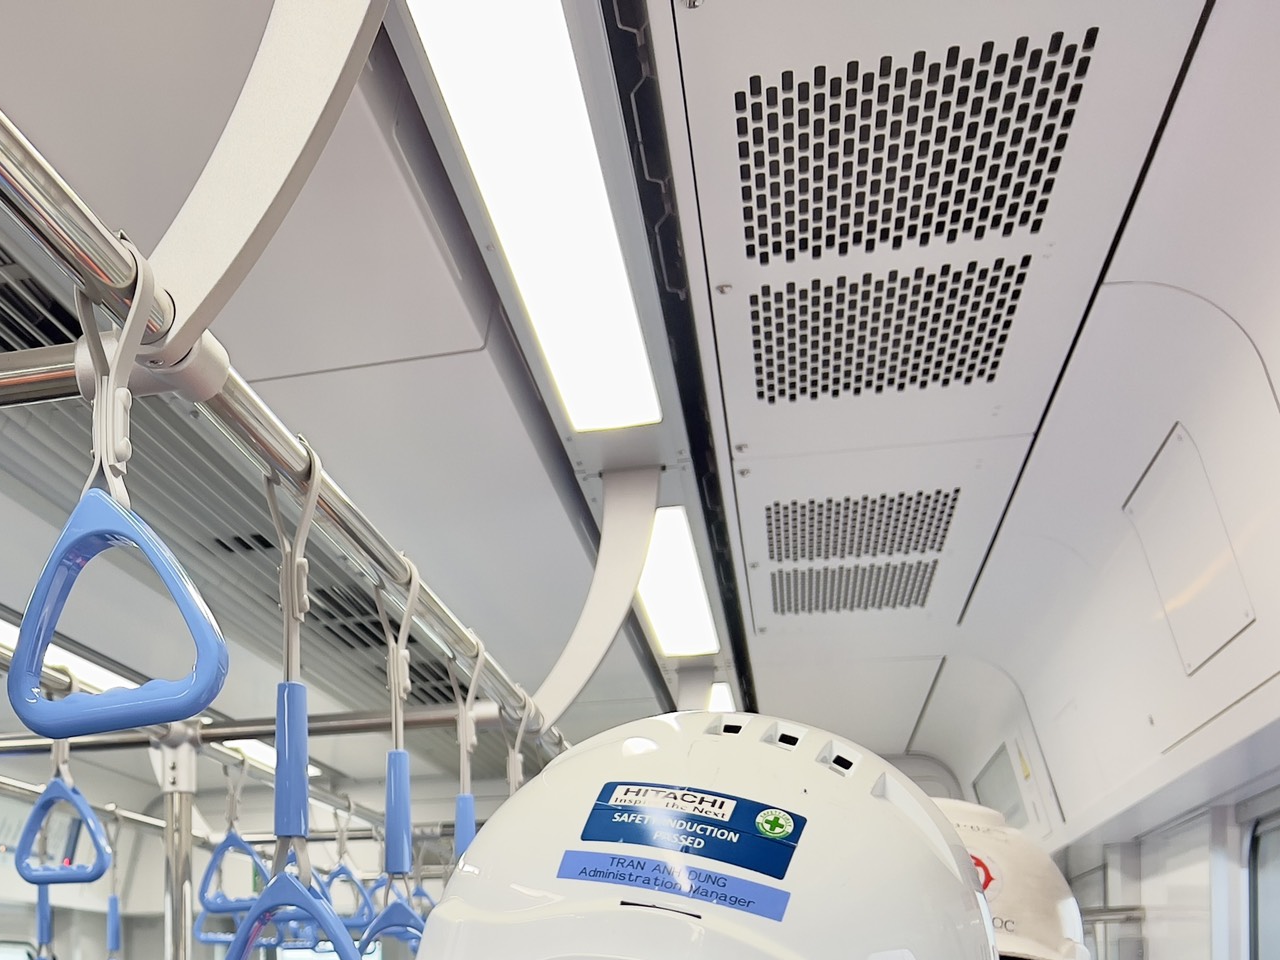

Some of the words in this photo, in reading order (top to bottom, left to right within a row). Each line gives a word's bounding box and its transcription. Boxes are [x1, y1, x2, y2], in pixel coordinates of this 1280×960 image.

[623, 787, 726, 810] HITACHI
[692, 806, 727, 819] Next
[612, 812, 656, 825] SAFET
[664, 816, 740, 844] NDUCTION
[653, 831, 706, 849] PASSED
[609, 856, 647, 871] TRAN
[687, 869, 728, 889] DUNG
[578, 867, 683, 891] Administration
[688, 883, 756, 909] Manager
